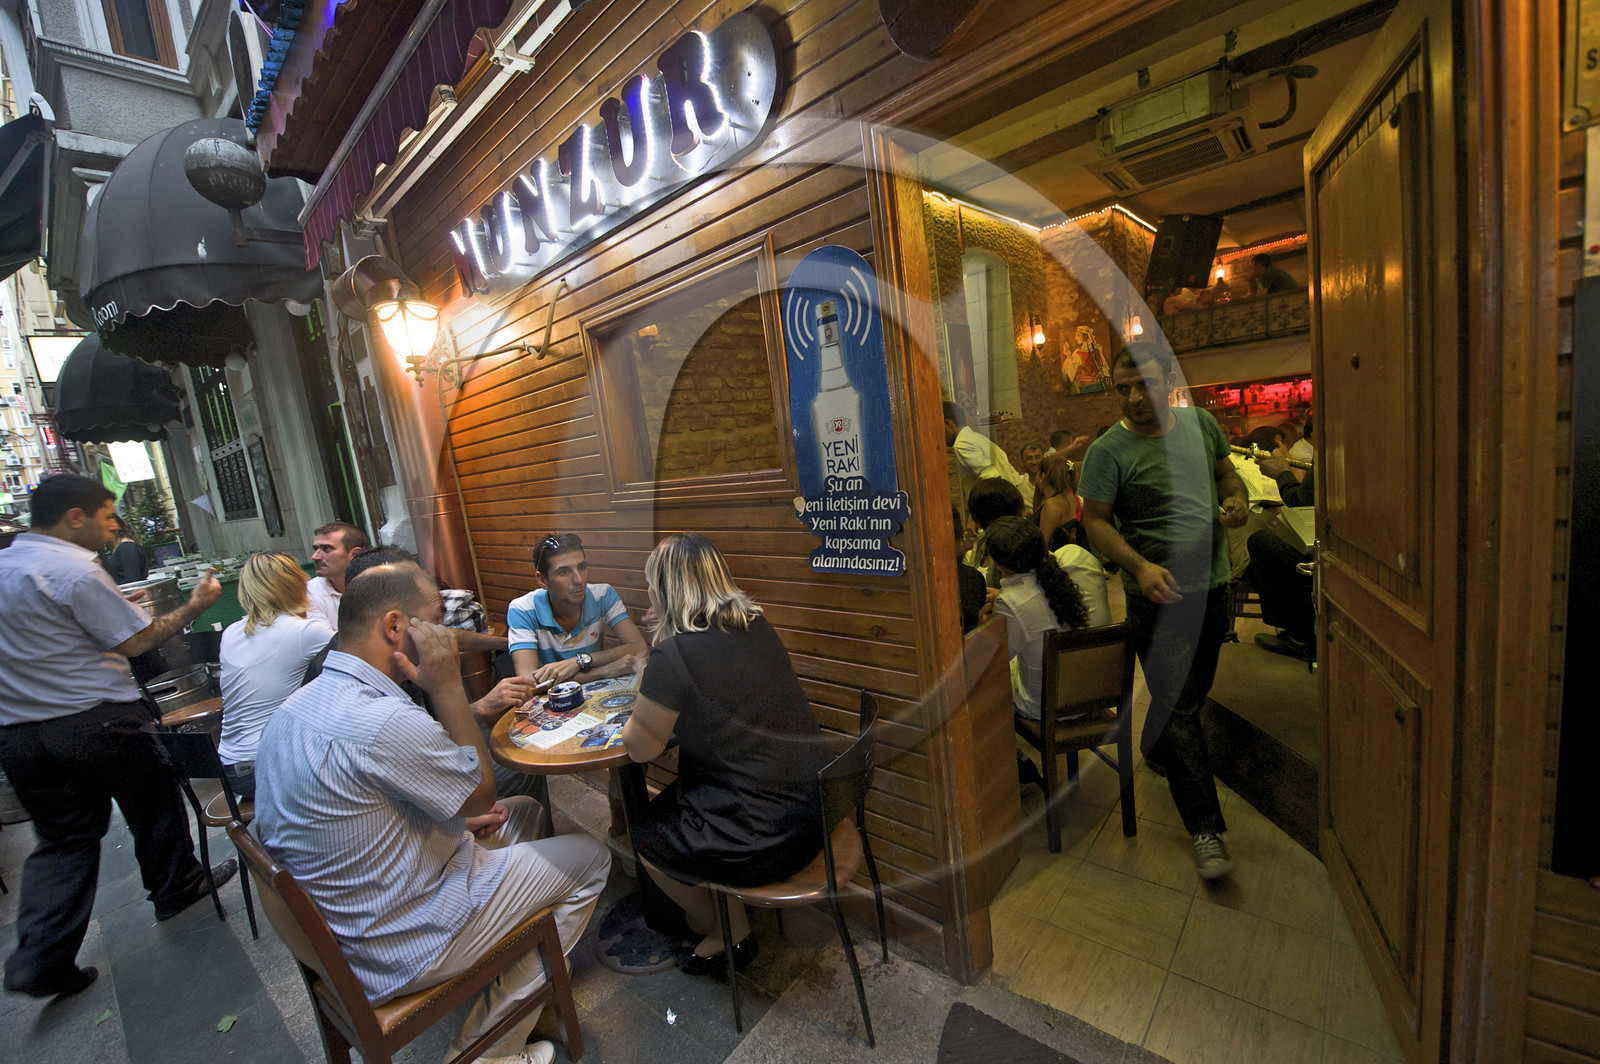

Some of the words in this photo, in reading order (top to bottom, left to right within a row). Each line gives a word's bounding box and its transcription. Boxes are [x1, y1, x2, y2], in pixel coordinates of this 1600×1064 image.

[449, 28, 730, 300] MUNZUR
[827, 477, 843, 495] Şu
[845, 478, 863, 491] an
[826, 496, 869, 515] iletişim
[872, 493, 901, 510] devi
[811, 516, 837, 531] Yeni
[825, 535, 881, 553] kapsama
[812, 554, 900, 572] alanındasınız!
